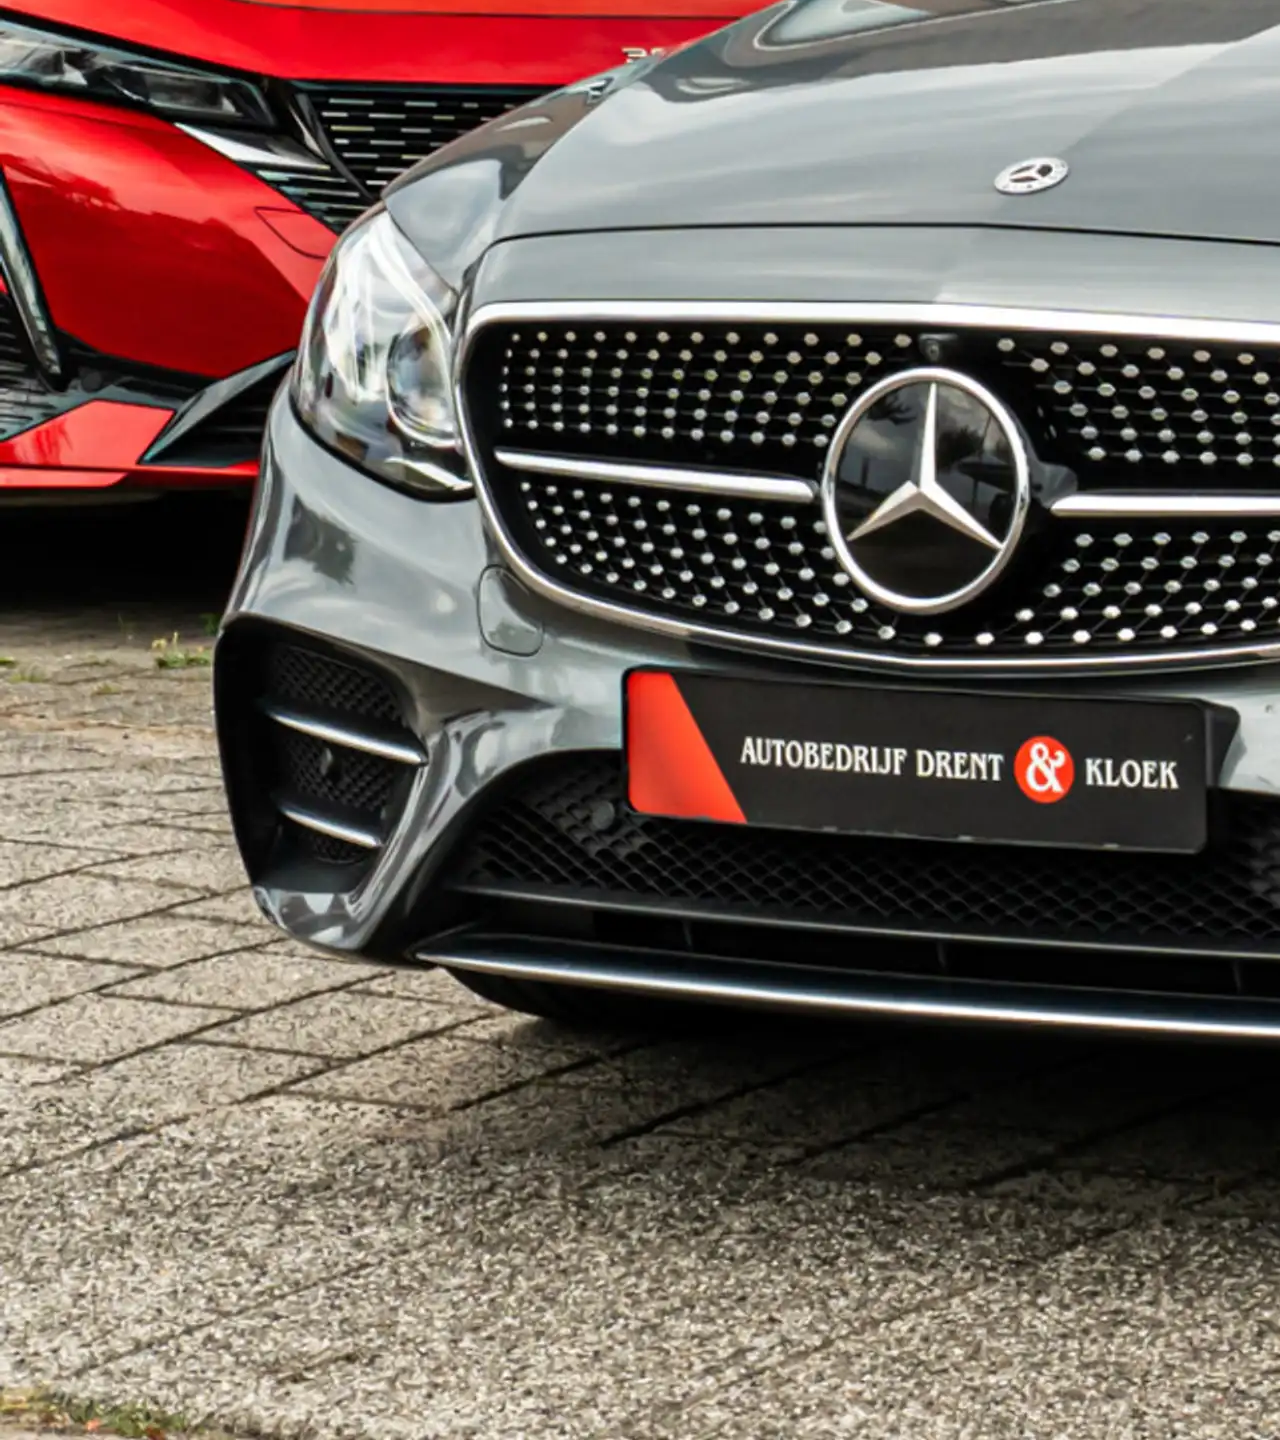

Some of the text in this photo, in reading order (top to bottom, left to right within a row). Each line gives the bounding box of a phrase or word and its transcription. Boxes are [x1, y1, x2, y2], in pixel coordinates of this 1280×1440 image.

[740, 735, 1180, 794] AUTOBEDRIJF DRENT & KLOEK
